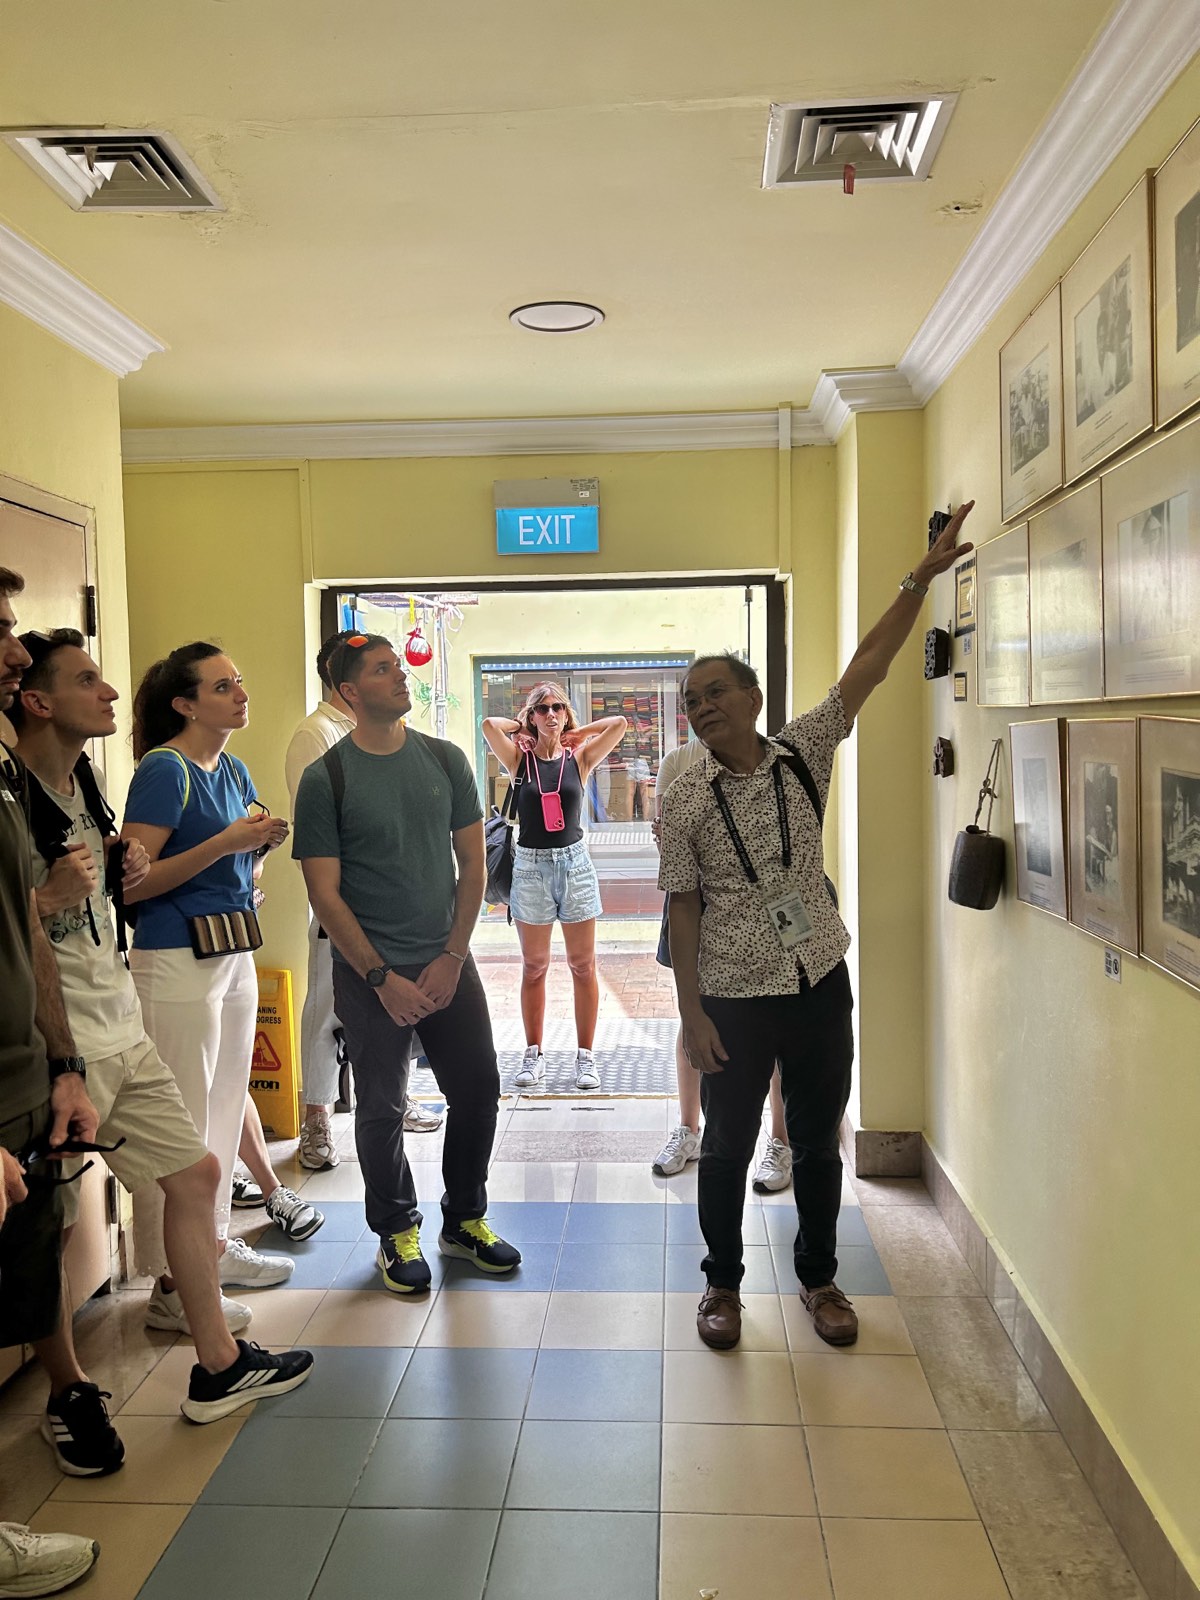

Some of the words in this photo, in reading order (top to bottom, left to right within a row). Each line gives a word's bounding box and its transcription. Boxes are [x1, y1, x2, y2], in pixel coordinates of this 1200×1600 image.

[518, 514, 576, 545] EXIT
[257, 1006, 277, 1015] ANING
[256, 1015, 282, 1025] OGRESS
